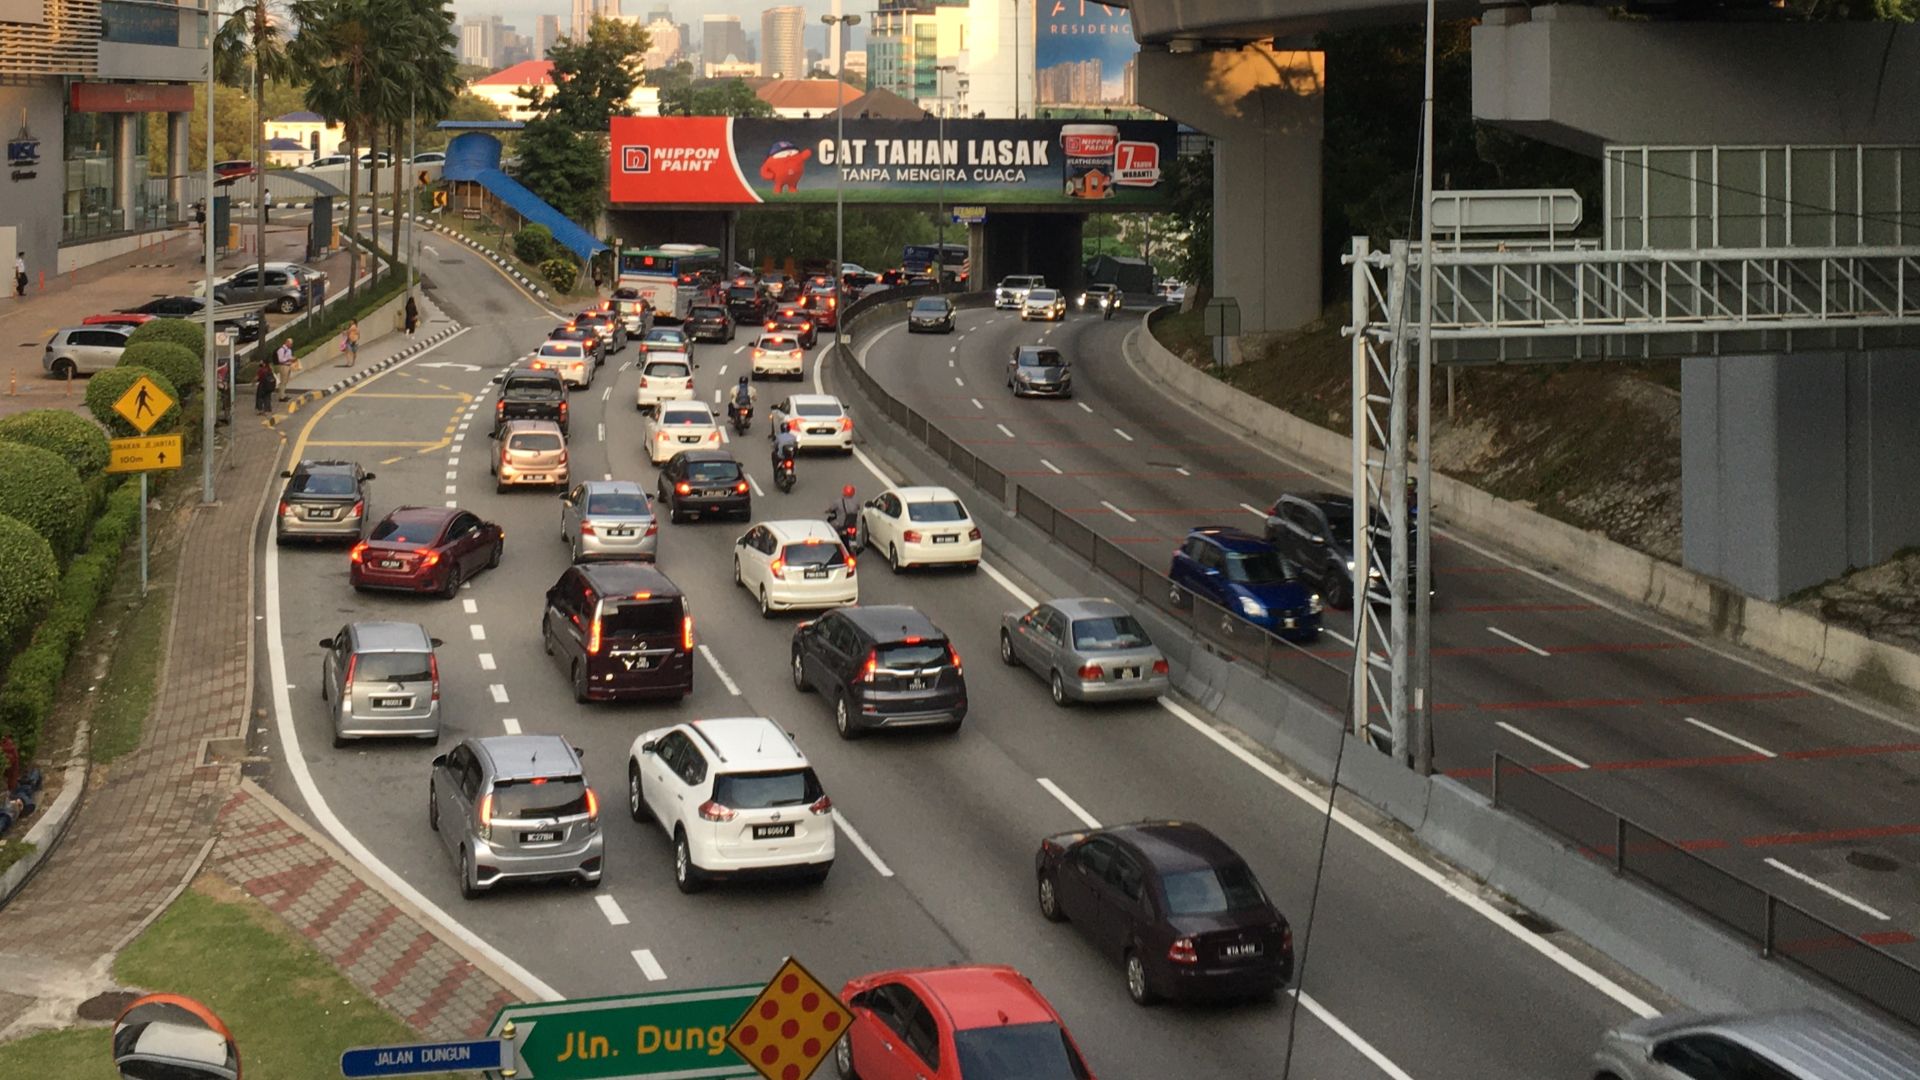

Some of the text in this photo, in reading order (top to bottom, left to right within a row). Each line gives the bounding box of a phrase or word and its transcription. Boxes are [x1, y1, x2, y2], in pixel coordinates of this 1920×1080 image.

[1081, 138, 1114, 146] NIPPON
[653, 147, 720, 160] NIPPON
[817, 138, 867, 166] CAT
[875, 138, 959, 166] TAHAN
[968, 138, 1049, 166] LASAK
[1121, 146, 1135, 171] 7
[660, 160, 713, 172] PAINT
[841, 168, 891, 182] TANPA
[896, 168, 968, 182] MENGIRA
[973, 168, 1027, 182] CUACA
[1121, 170, 1153, 179] WARANTI
[120, 455, 144, 464] 100m
[556, 1024, 735, 1063] Jln. Dung
[374, 1046, 471, 1067] JALAN DUNGUN
